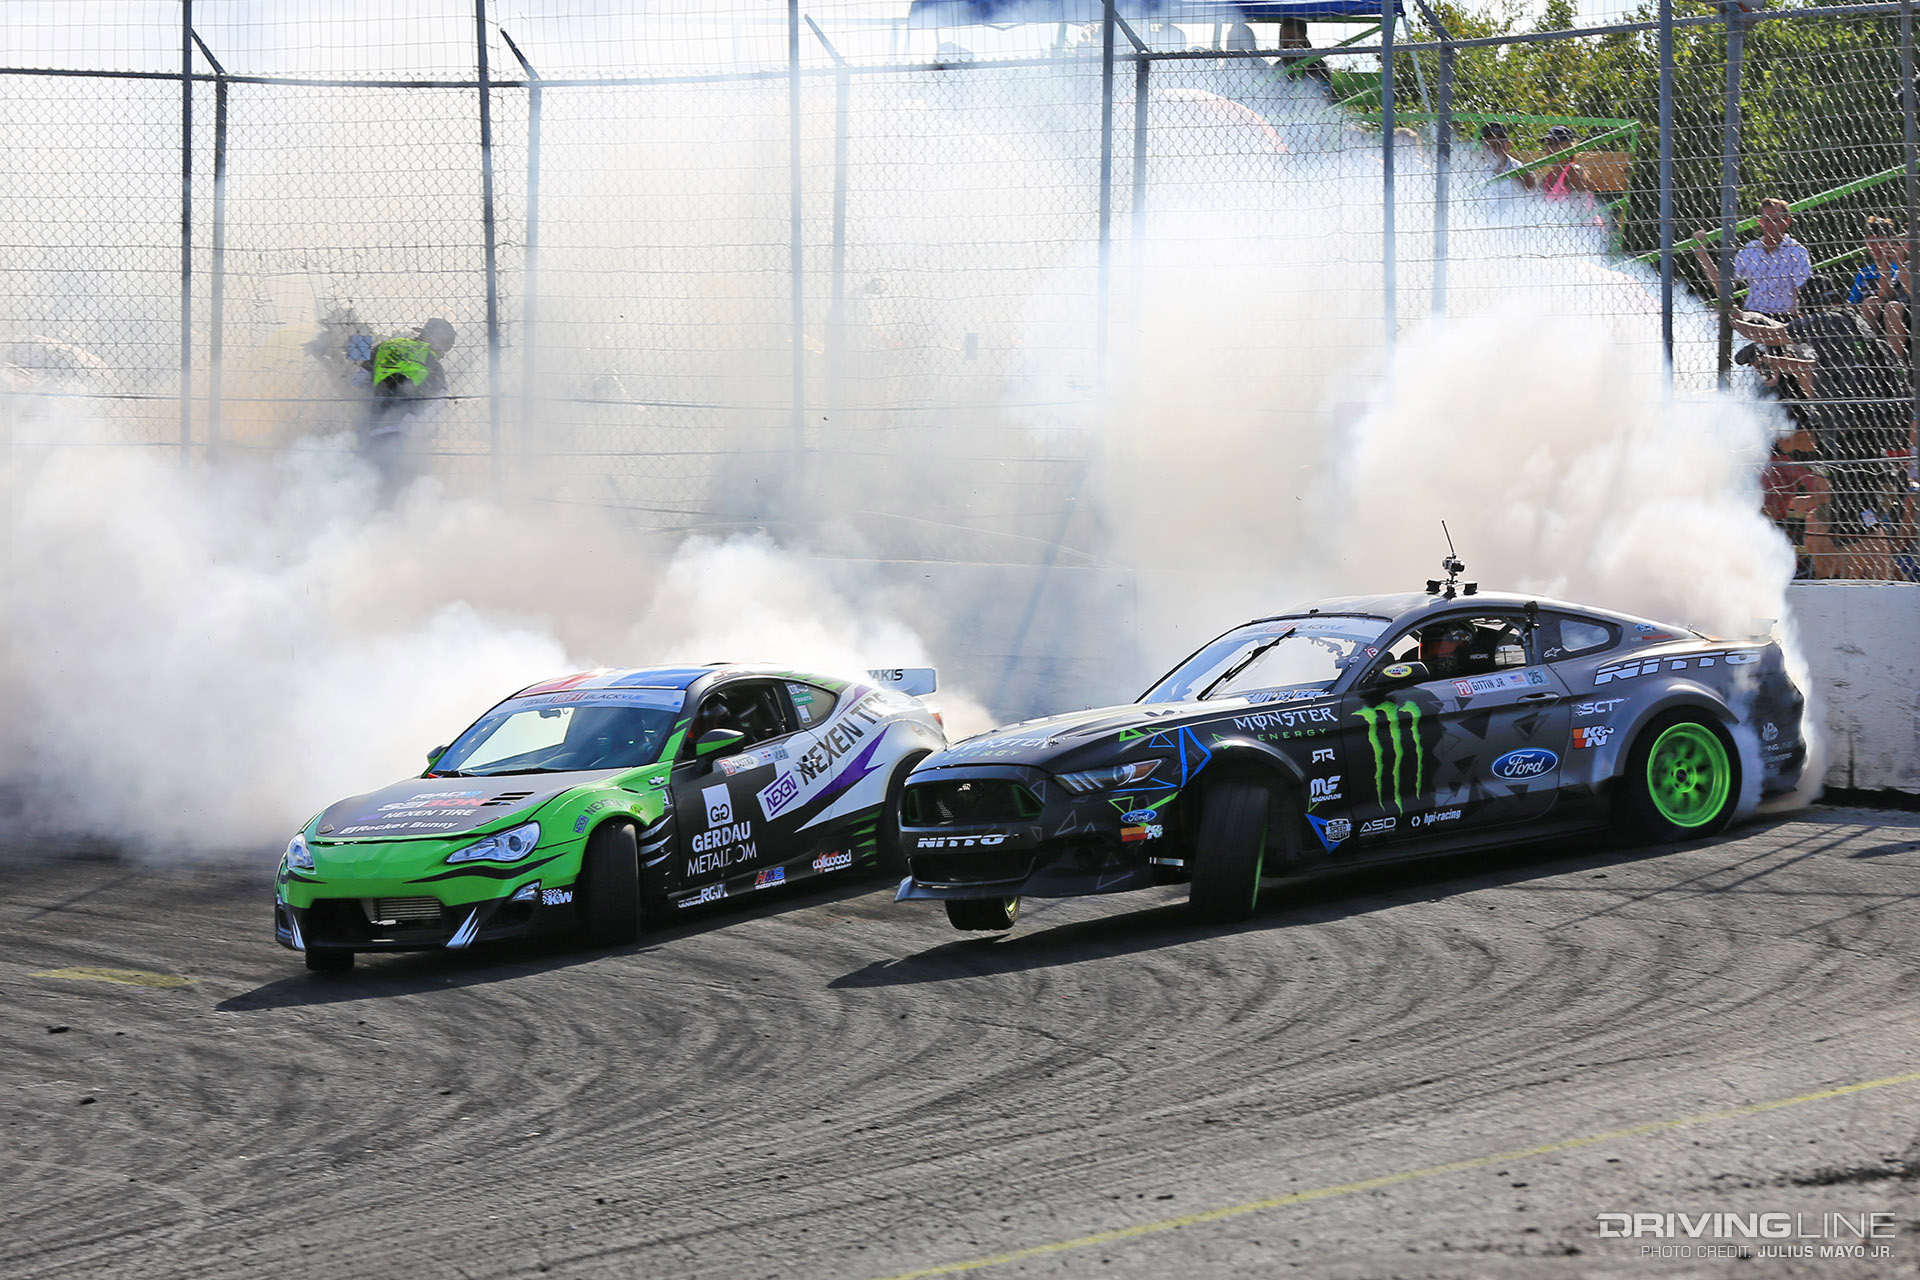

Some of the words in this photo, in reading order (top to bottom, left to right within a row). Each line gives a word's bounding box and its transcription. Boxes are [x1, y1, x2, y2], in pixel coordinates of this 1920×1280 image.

[1593, 650, 1760, 687] NITTO
[1472, 679, 1494, 692] GITTIN
[1495, 677, 1506, 689] JR
[1528, 671, 1543, 685] 25
[1580, 698, 1625, 716] SCT
[1233, 707, 1338, 731] MONSTER
[1257, 728, 1327, 741] ENERGY
[1504, 753, 1546, 777] Ford
[383, 809, 438, 819] NEXEN
[438, 808, 478, 817] TIRE
[1127, 811, 1150, 822] Ford
[1423, 808, 1462, 826] hpi-racing
[354, 821, 408, 833] Rocket
[408, 821, 459, 830] Bunny
[692, 820, 751, 853] GERDAU
[917, 833, 1009, 849] NITTO
[754, 866, 785, 885] HMS
